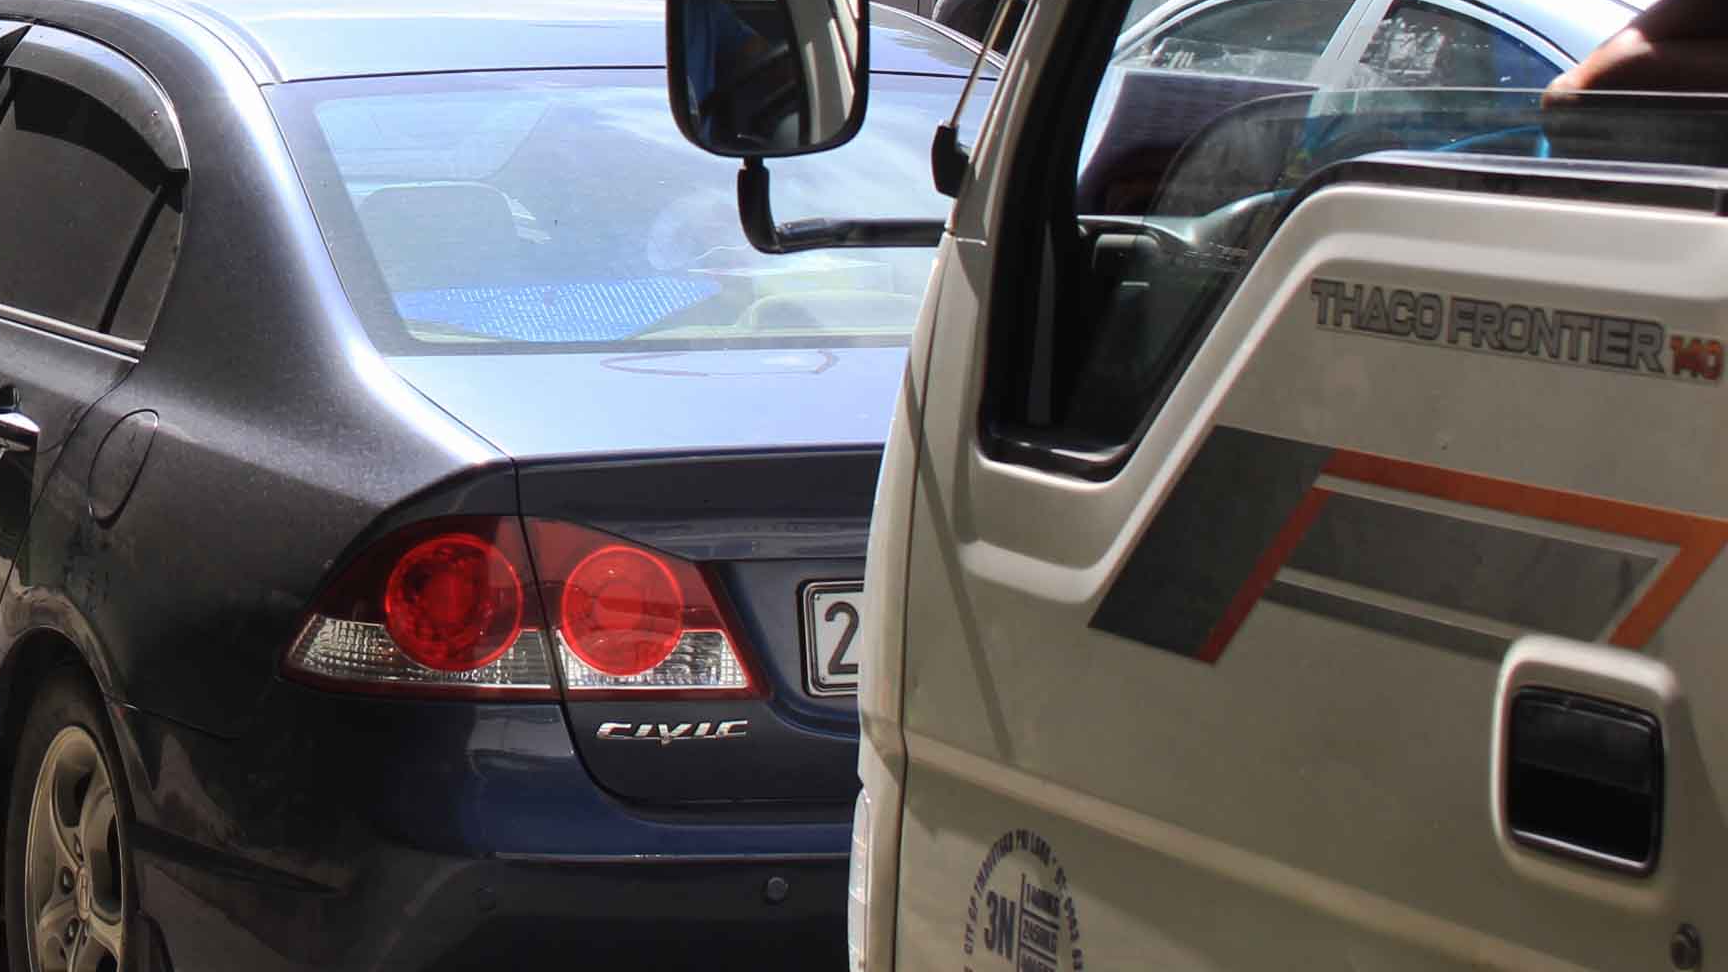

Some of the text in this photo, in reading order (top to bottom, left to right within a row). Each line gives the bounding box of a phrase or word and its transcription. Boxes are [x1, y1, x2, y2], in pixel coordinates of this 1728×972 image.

[1310, 278, 1443, 342] THACO
[1447, 296, 1666, 375] FRONTIER
[596, 719, 748, 746] CIVIC
